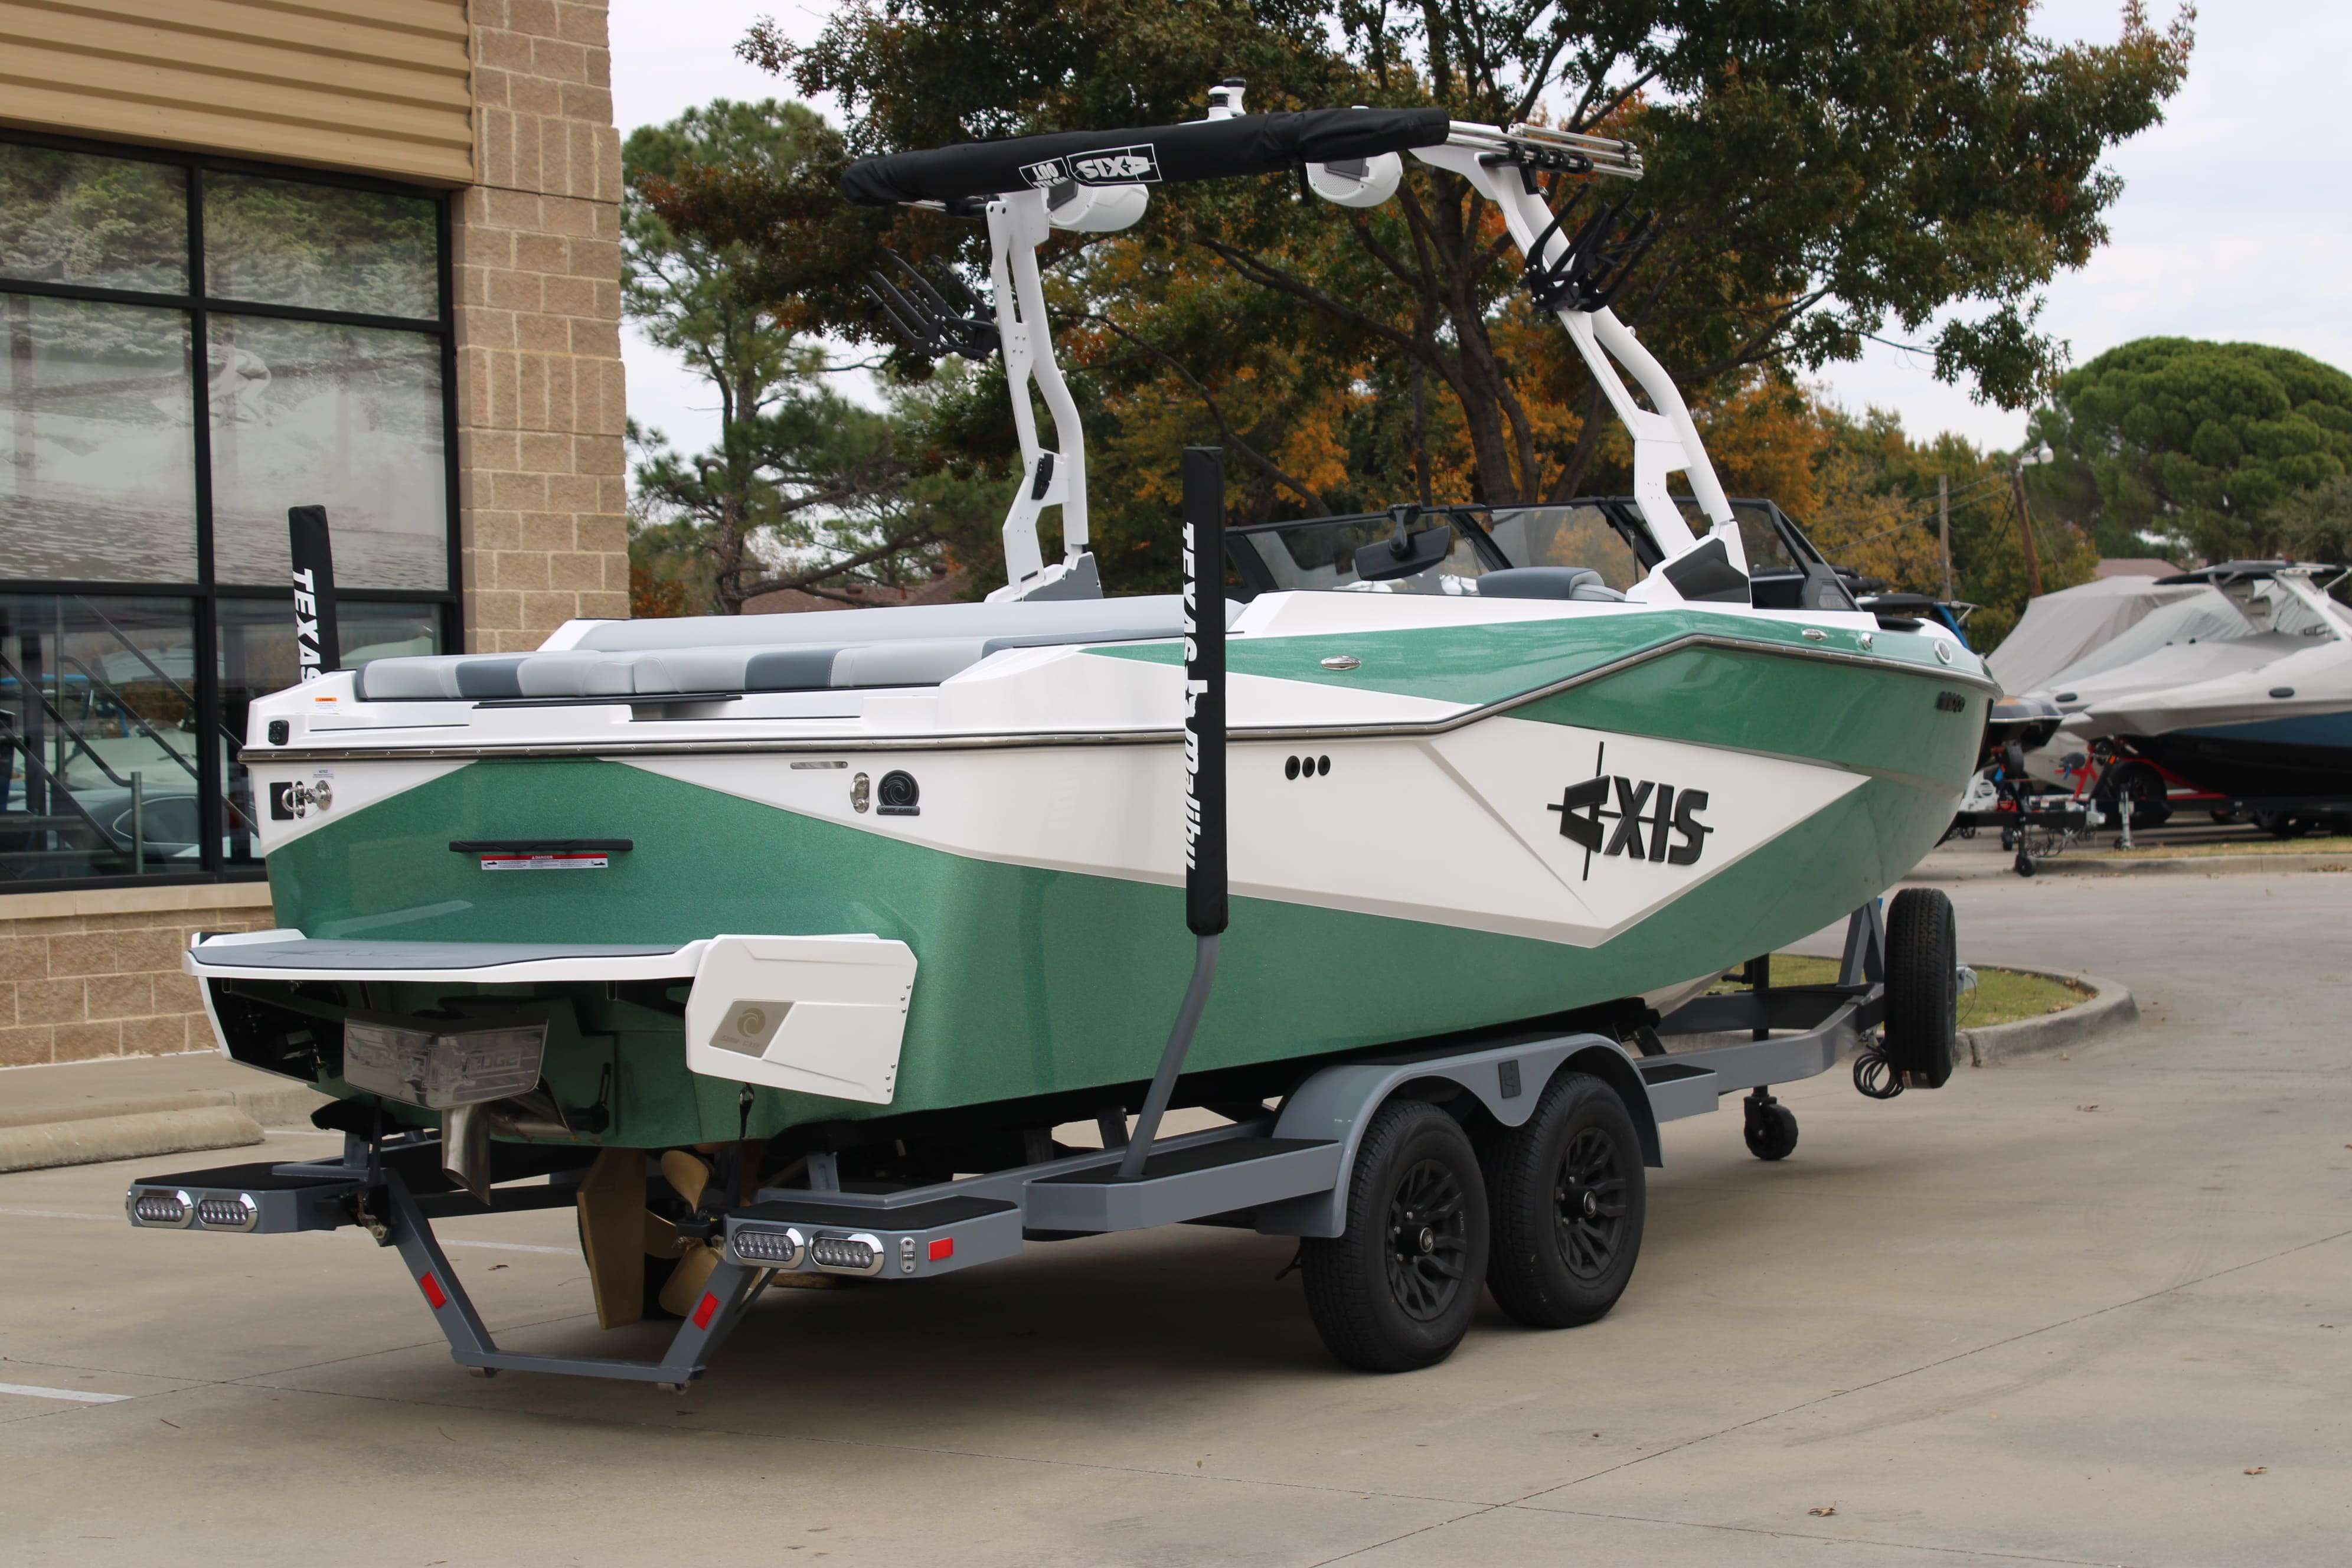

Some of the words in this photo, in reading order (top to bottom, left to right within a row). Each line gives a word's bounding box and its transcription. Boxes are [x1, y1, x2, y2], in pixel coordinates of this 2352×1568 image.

[1031, 162, 1059, 181] OUT
[1076, 156, 1151, 179] AXIS
[1557, 772, 1711, 867] AXIS
